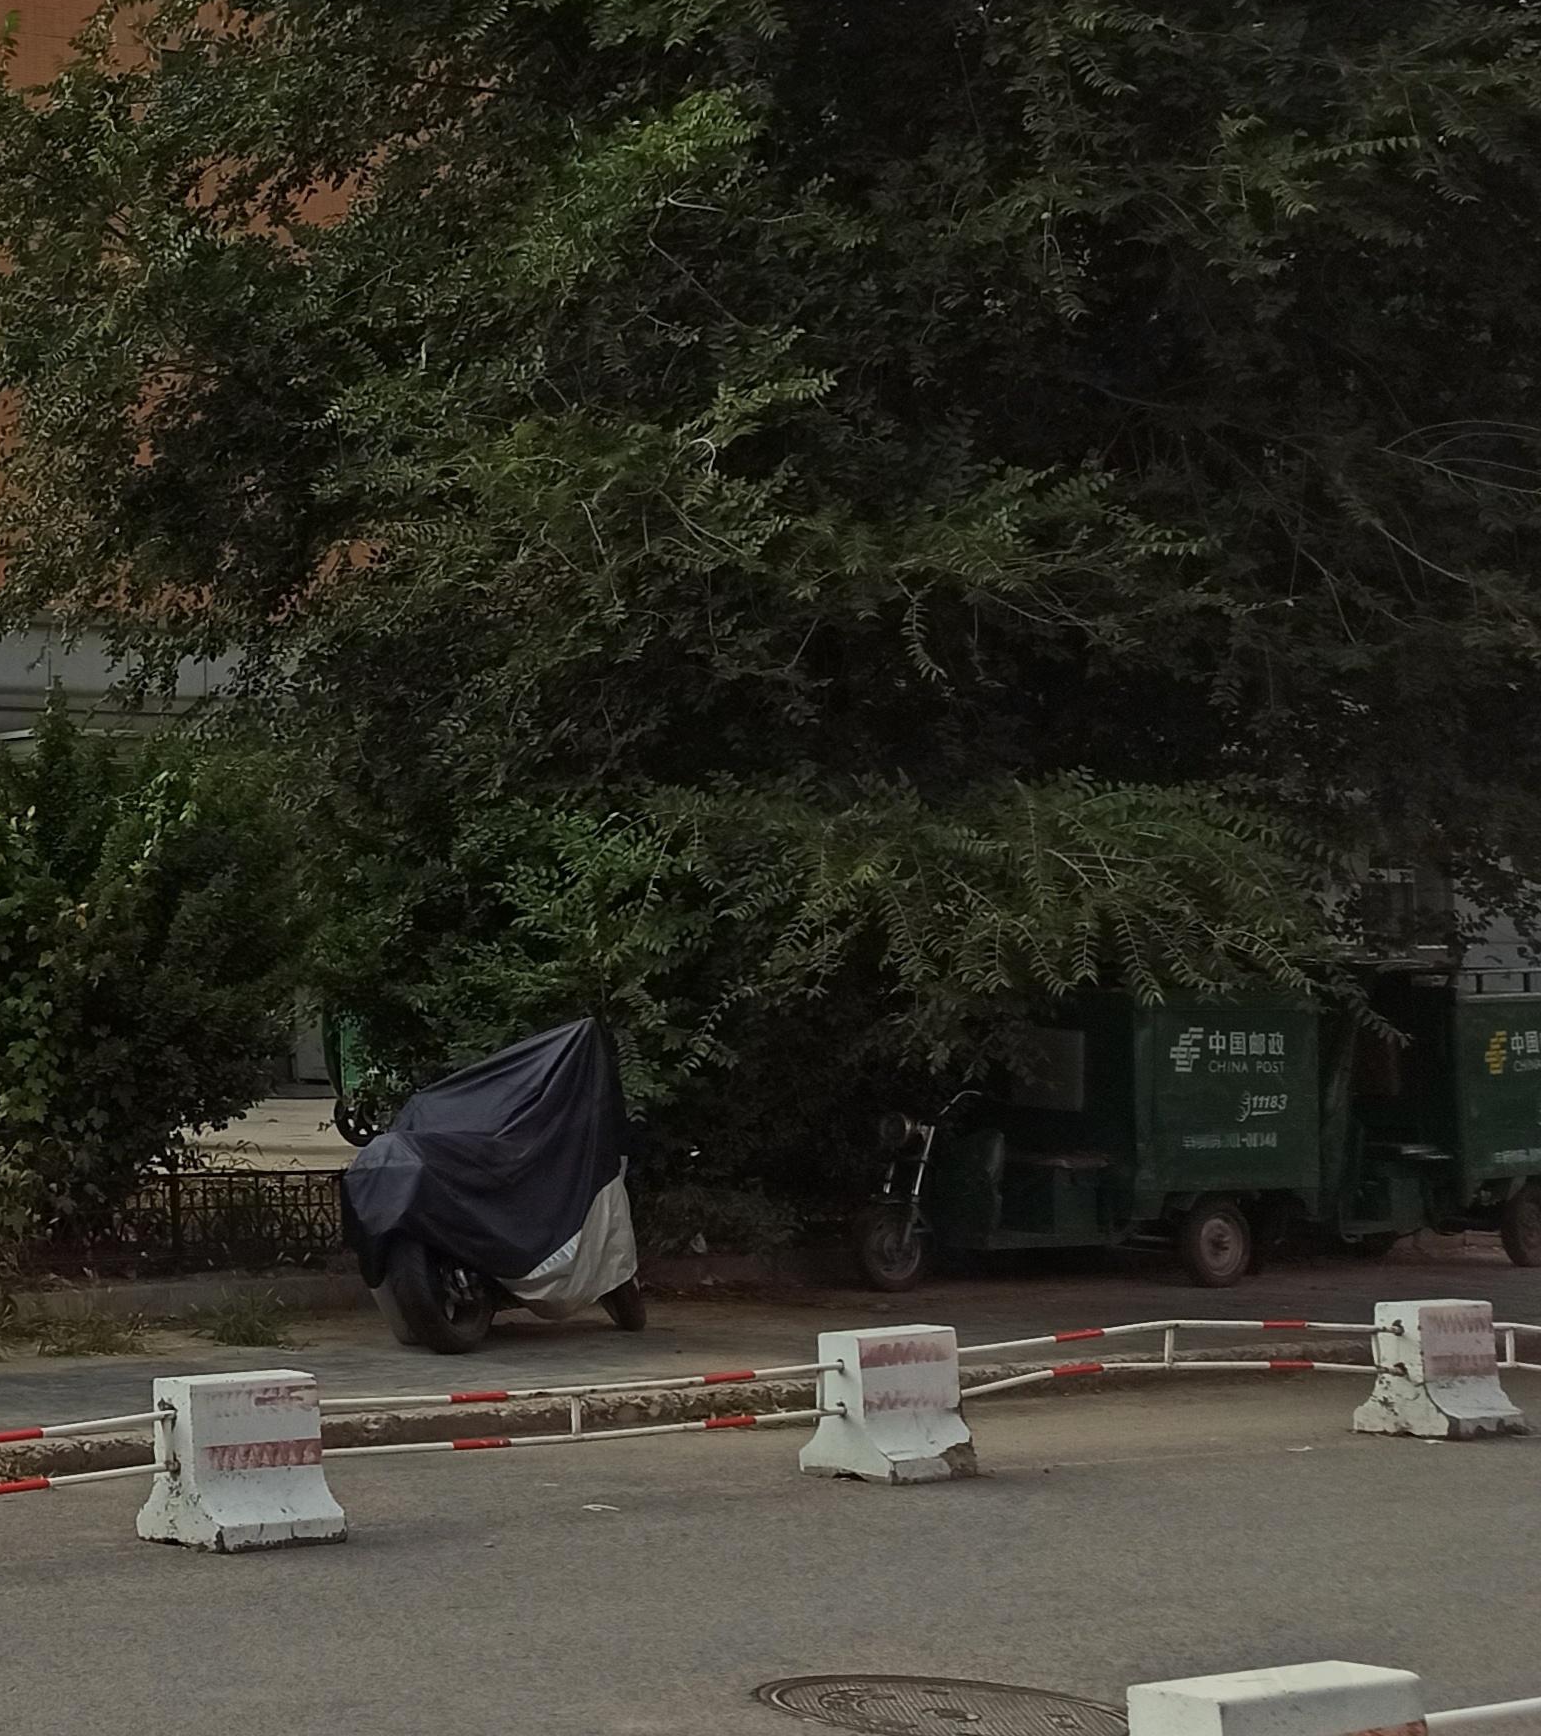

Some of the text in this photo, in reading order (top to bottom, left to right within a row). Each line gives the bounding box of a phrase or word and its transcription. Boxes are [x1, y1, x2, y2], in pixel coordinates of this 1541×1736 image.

[1208, 1030, 1285, 1055] 中国邮政
[1510, 1031, 1541, 1055] 中国
[1208, 1060, 1285, 1073] CHINA POST
[1252, 1094, 1288, 1110] 11183
